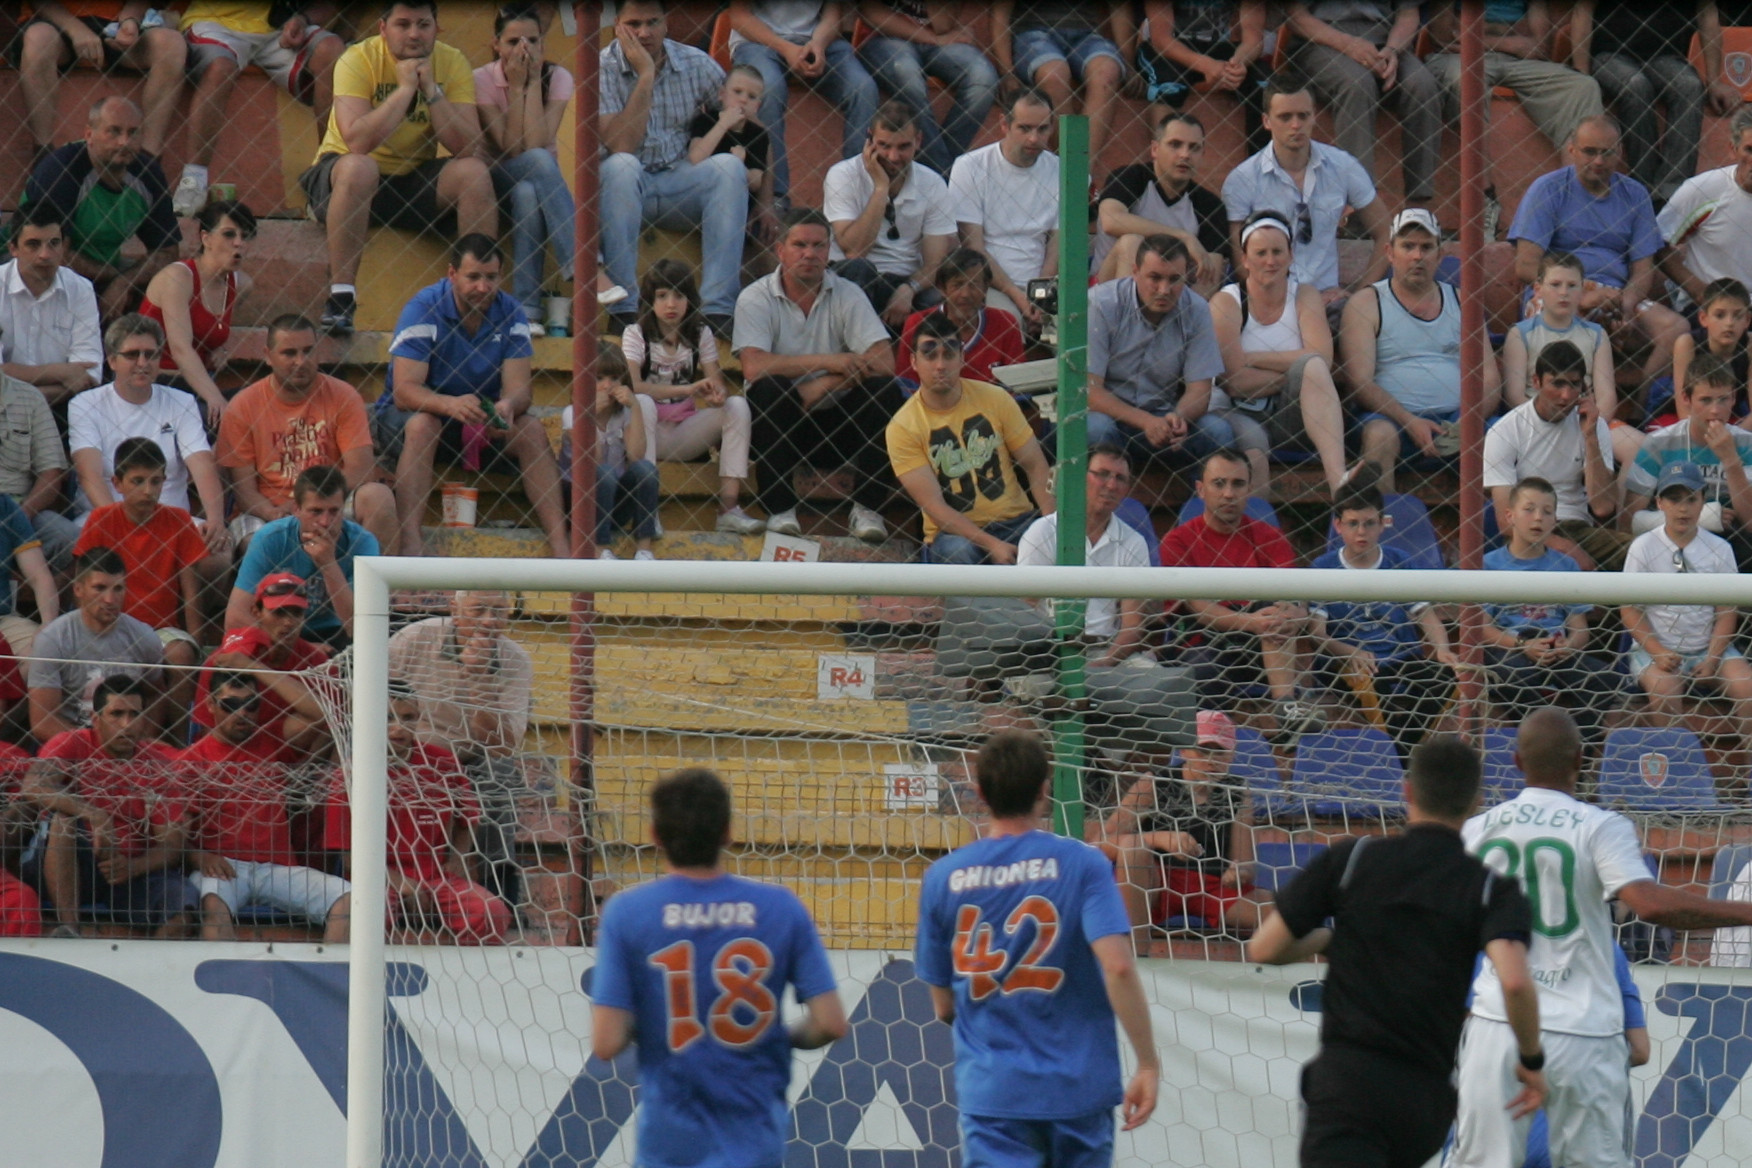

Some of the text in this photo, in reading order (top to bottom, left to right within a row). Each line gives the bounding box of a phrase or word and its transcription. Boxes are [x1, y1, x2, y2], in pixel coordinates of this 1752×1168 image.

[829, 667, 864, 688] R4
[893, 776, 925, 798] R3
[949, 857, 1059, 894] GHIONEA
[663, 901, 758, 929] BUJOR
[951, 895, 1065, 1001] 42
[648, 937, 776, 1054] 18
